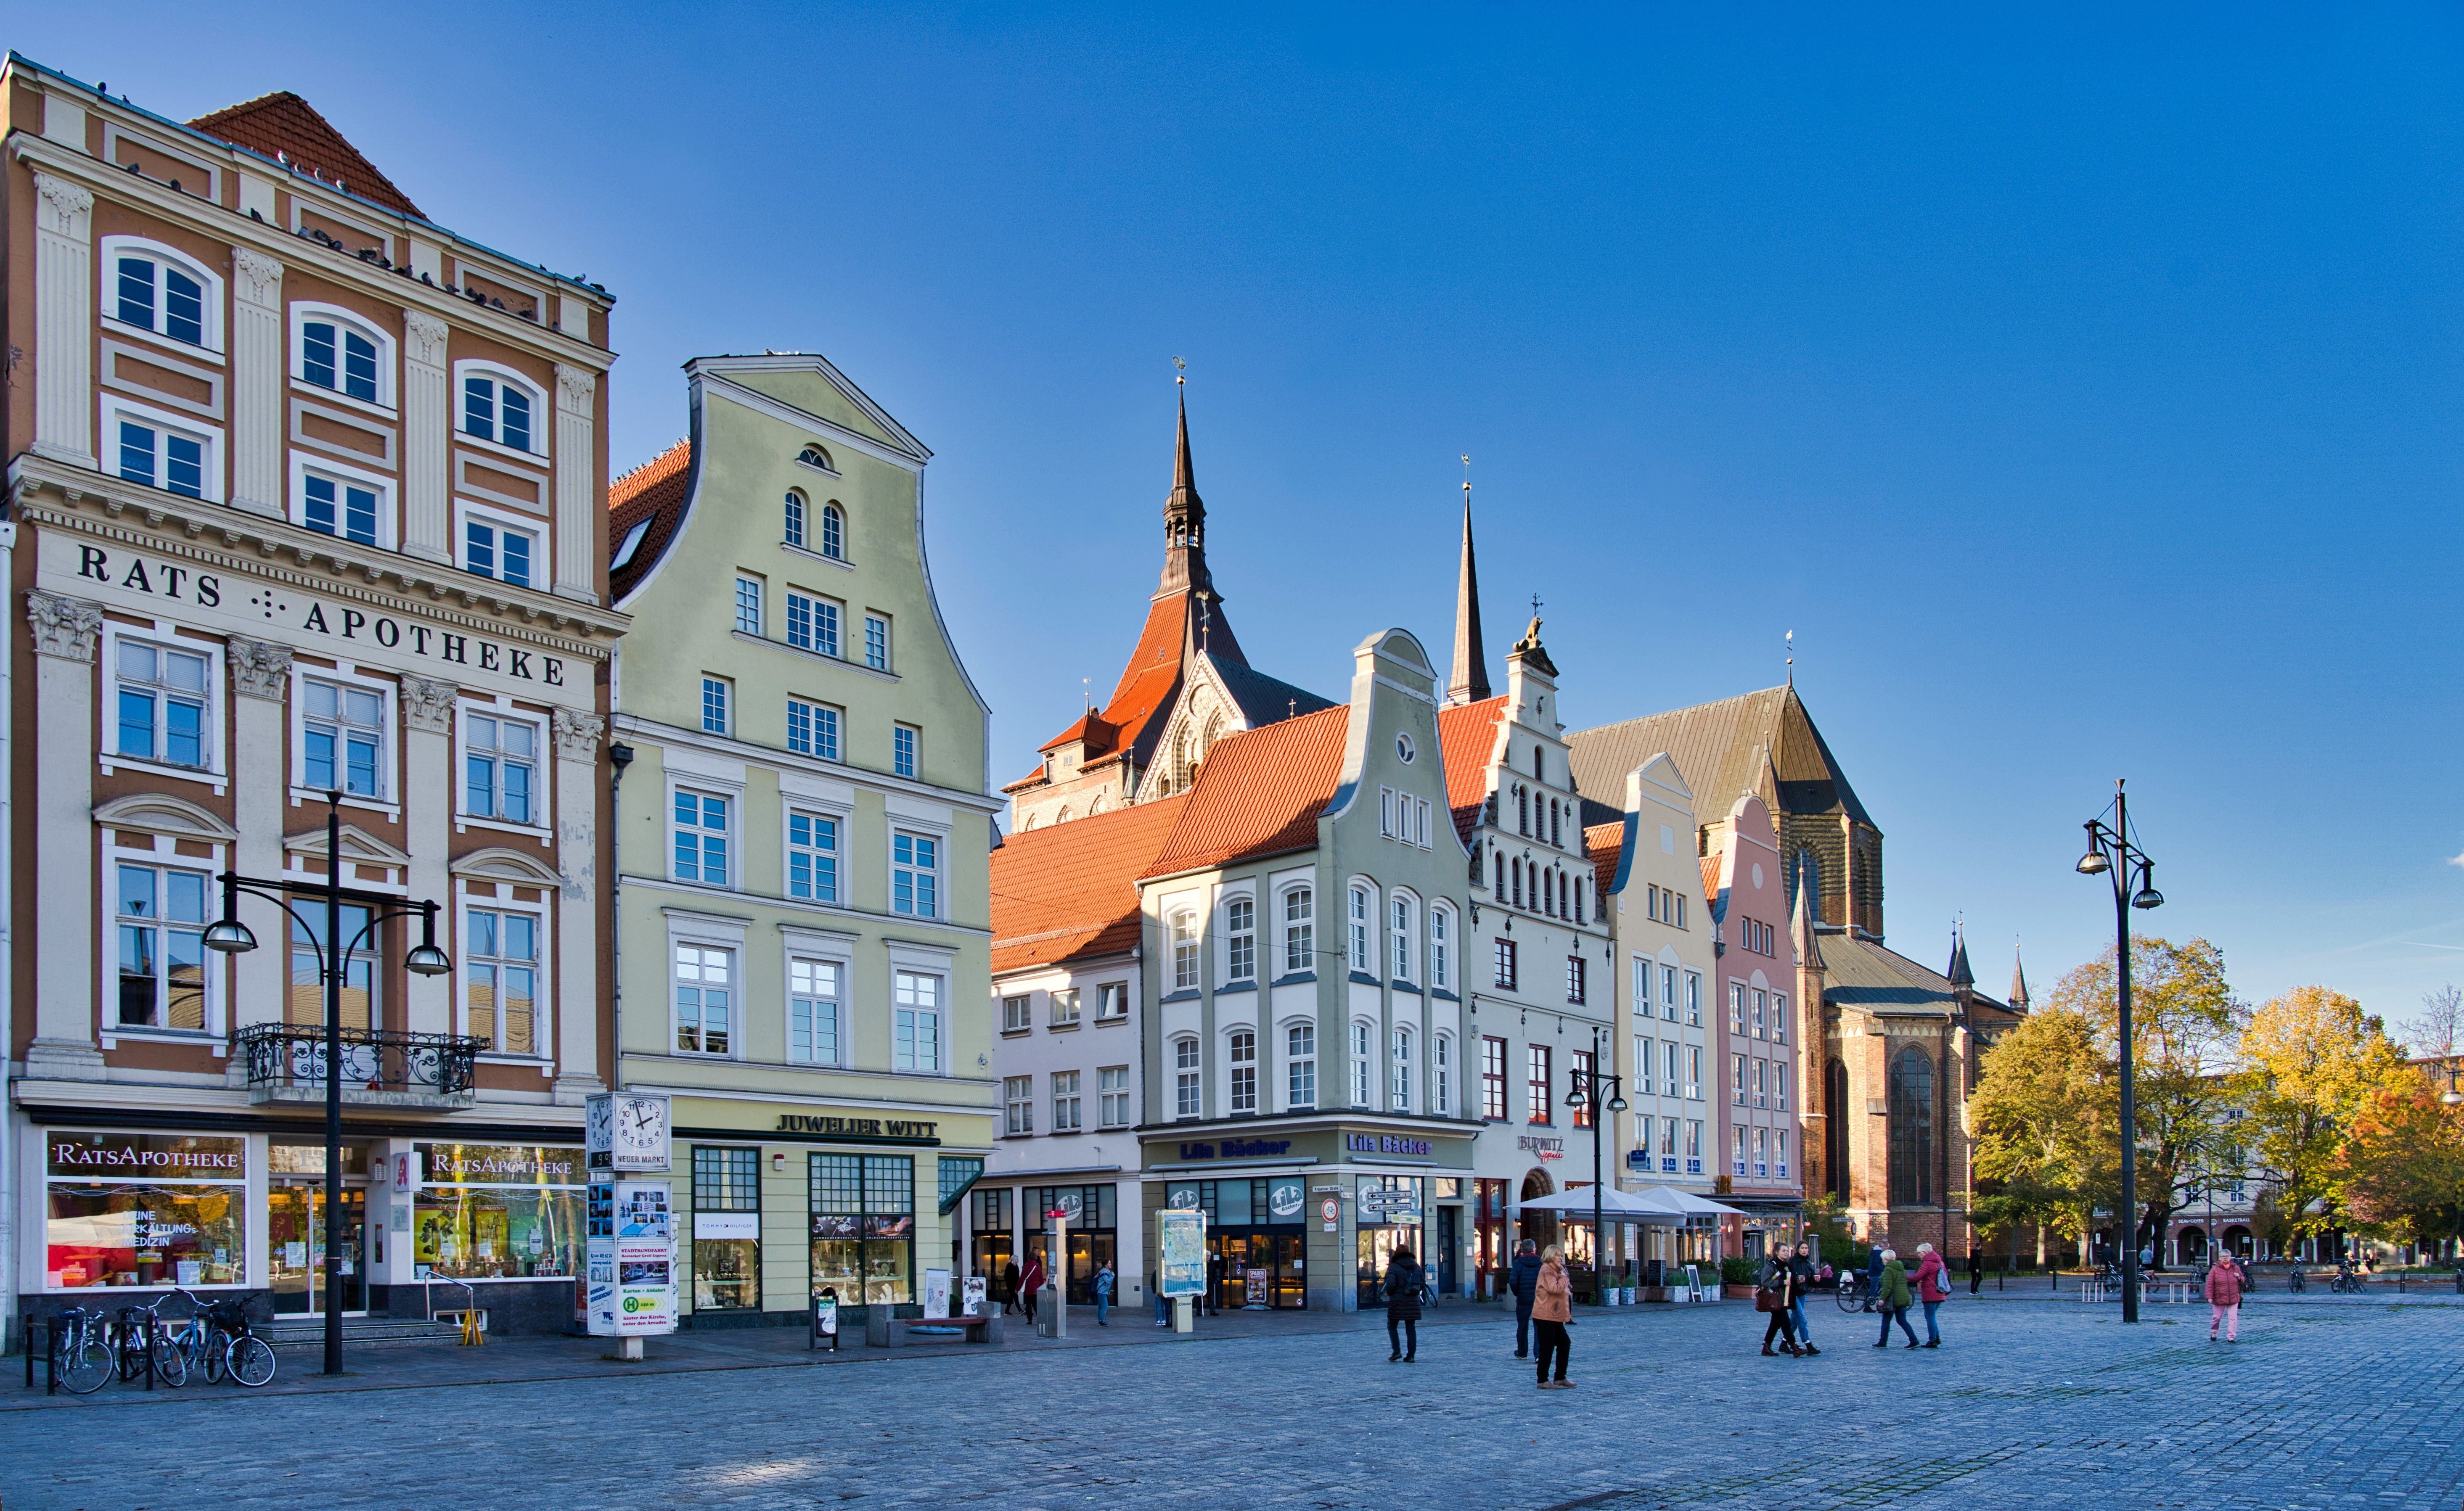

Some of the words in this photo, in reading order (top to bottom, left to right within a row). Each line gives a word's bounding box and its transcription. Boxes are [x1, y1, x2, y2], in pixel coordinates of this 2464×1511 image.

[77, 544, 220, 608] RATS
[303, 603, 563, 687] APOTHEKE
[777, 1115, 883, 1135] JUWELIER
[885, 1120, 938, 1136] WITT
[1180, 1143, 1214, 1159] Lila
[1221, 1139, 1291, 1157] Bäcker
[1348, 1134, 1376, 1152] Lila
[1382, 1136, 1432, 1155] Bäcker
[124, 1210, 156, 1220] DEINE
[123, 1237, 169, 1247] MEDIZIN
[603, 1311, 613, 1321] WG
